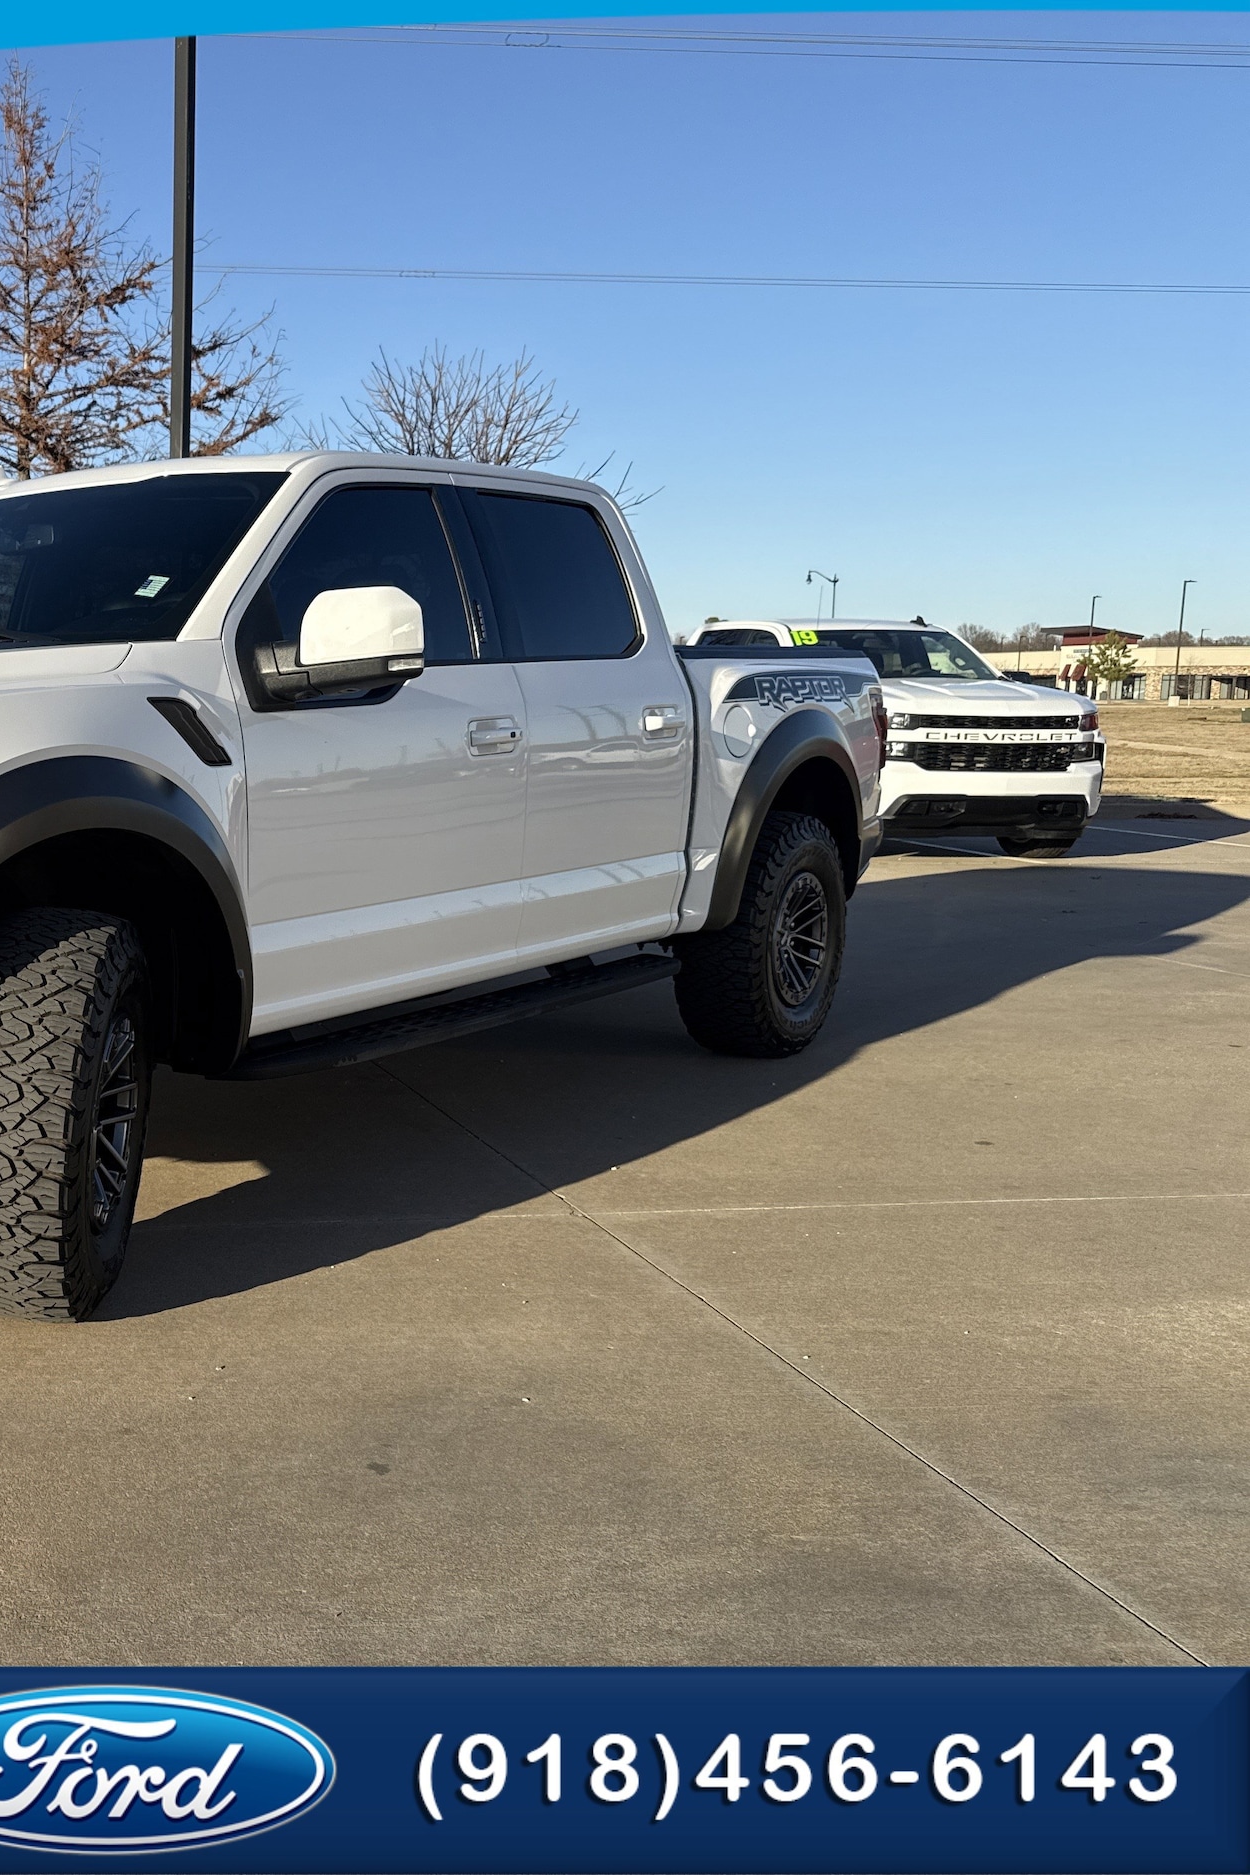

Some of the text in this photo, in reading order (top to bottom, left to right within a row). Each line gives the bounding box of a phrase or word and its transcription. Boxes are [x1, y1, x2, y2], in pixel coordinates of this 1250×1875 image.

[791, 630, 819, 646] 19
[754, 676, 855, 713] RAPTOR
[925, 732, 1078, 742] CHEVROLET
